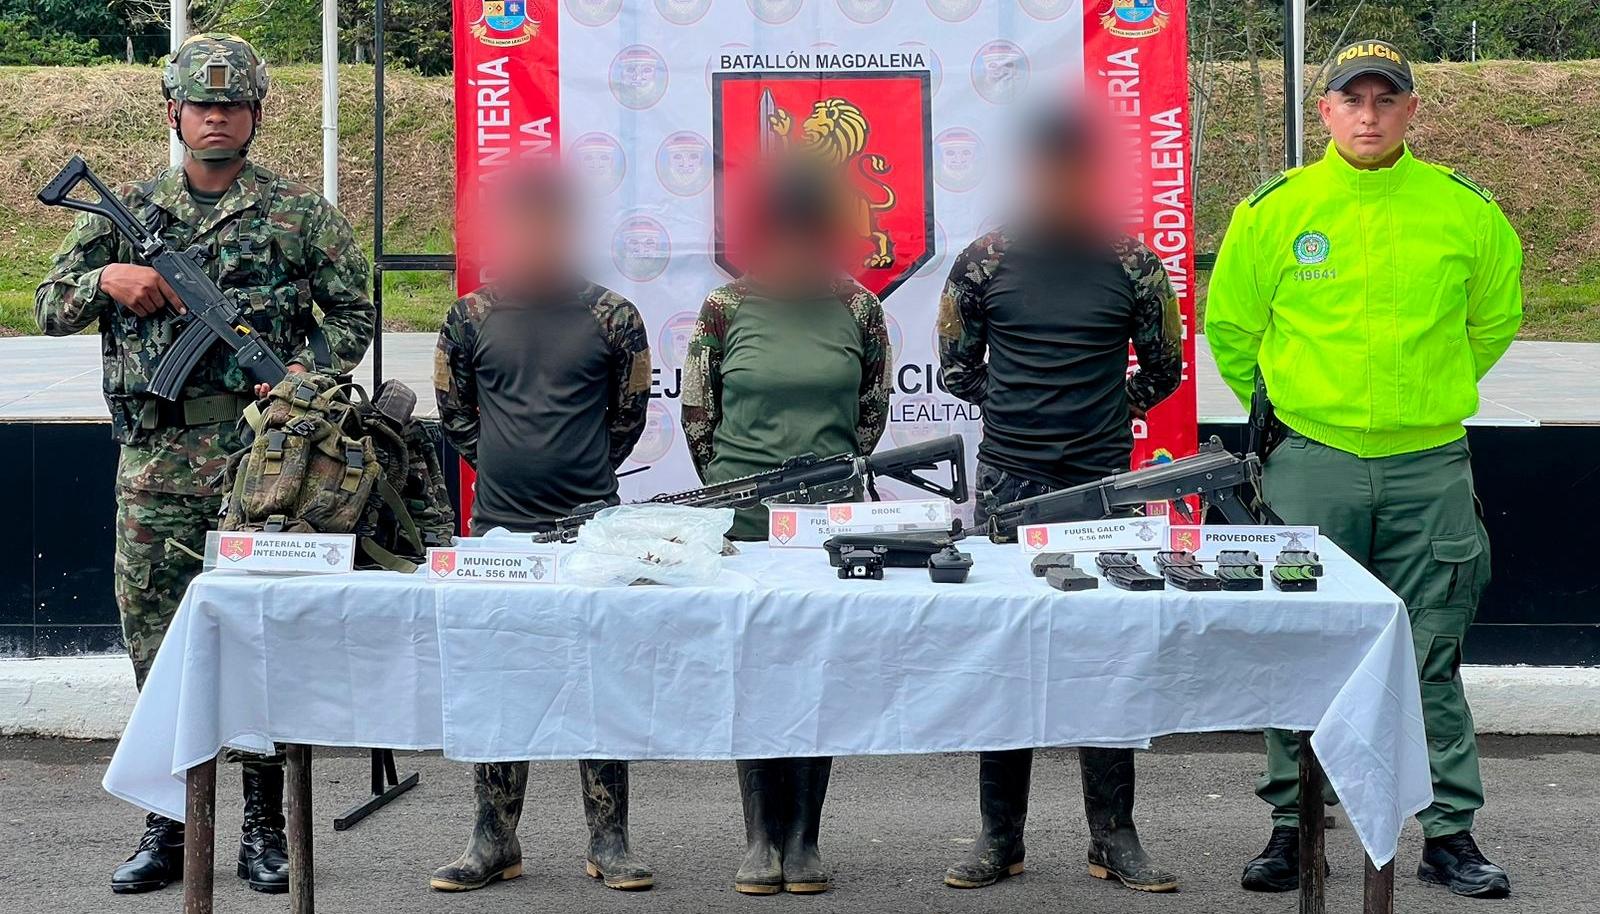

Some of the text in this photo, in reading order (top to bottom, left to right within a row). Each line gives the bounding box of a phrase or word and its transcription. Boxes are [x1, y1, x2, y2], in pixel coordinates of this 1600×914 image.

[1337, 43, 1402, 66] POLICIA
[720, 51, 926, 70] BATALLÓN MAGDALENA
[1149, 106, 1188, 298] MAGDALENA
[890, 403, 982, 422] LEALTAD
[871, 507, 901, 515] DRONE
[810, 518, 829, 526] FUS
[1064, 525, 1125, 535] FUUSIL GALEO
[1205, 533, 1276, 542] PROVEDORES
[255, 540, 317, 549] MATERIAL DE
[253, 549, 317, 558] INTENDENCIA
[463, 557, 522, 567] MUNICION
[456, 568, 527, 579] CAL. 556 MM
